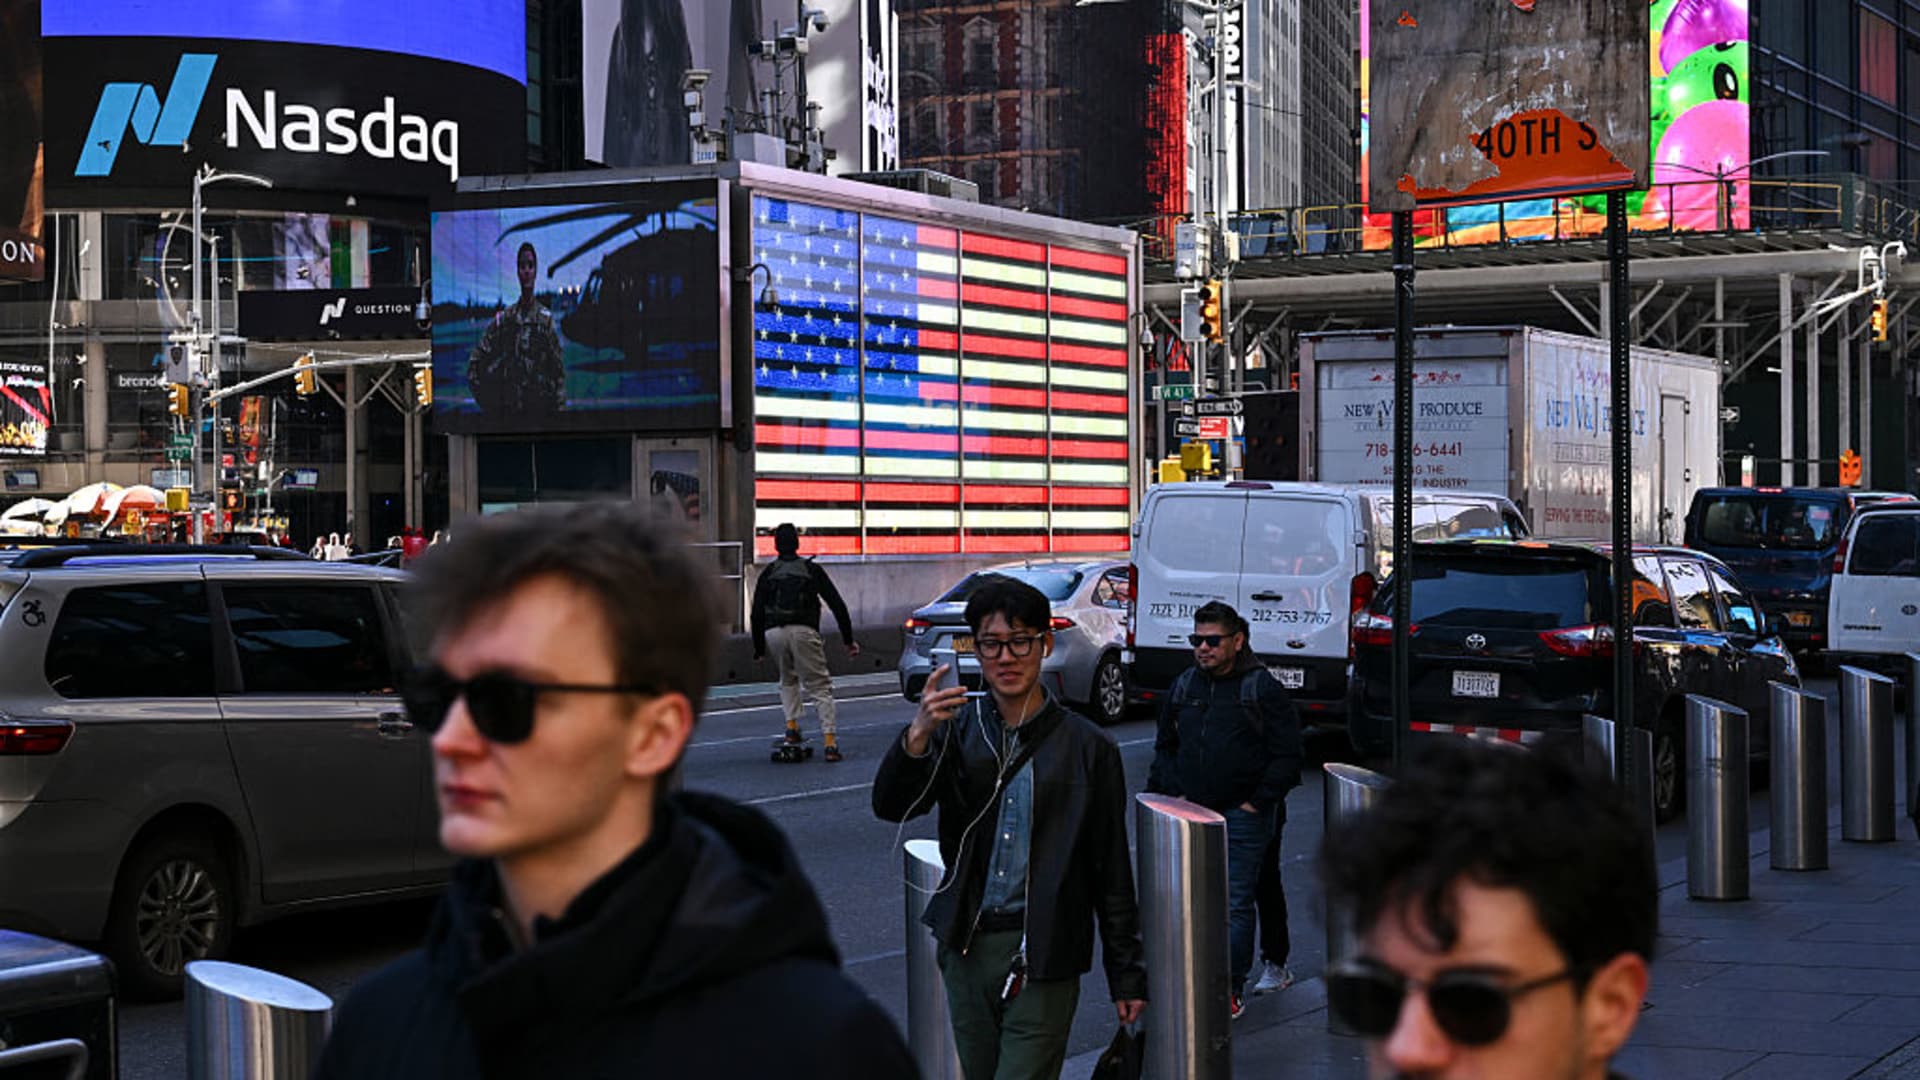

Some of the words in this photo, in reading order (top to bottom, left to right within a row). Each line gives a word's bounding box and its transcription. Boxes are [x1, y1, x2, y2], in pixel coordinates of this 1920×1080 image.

[226, 88, 459, 183] Nasdaq
[1476, 116, 1561, 160] 40TH
[354, 304, 412, 314] QUESTION
[1344, 403, 1375, 417] NEW
[1419, 402, 1483, 417] PRODUCE
[1365, 441, 1463, 458] 718-6-6441
[1423, 478, 1469, 488] INDUSTRY
[1252, 608, 1332, 624] 212-753-7767
